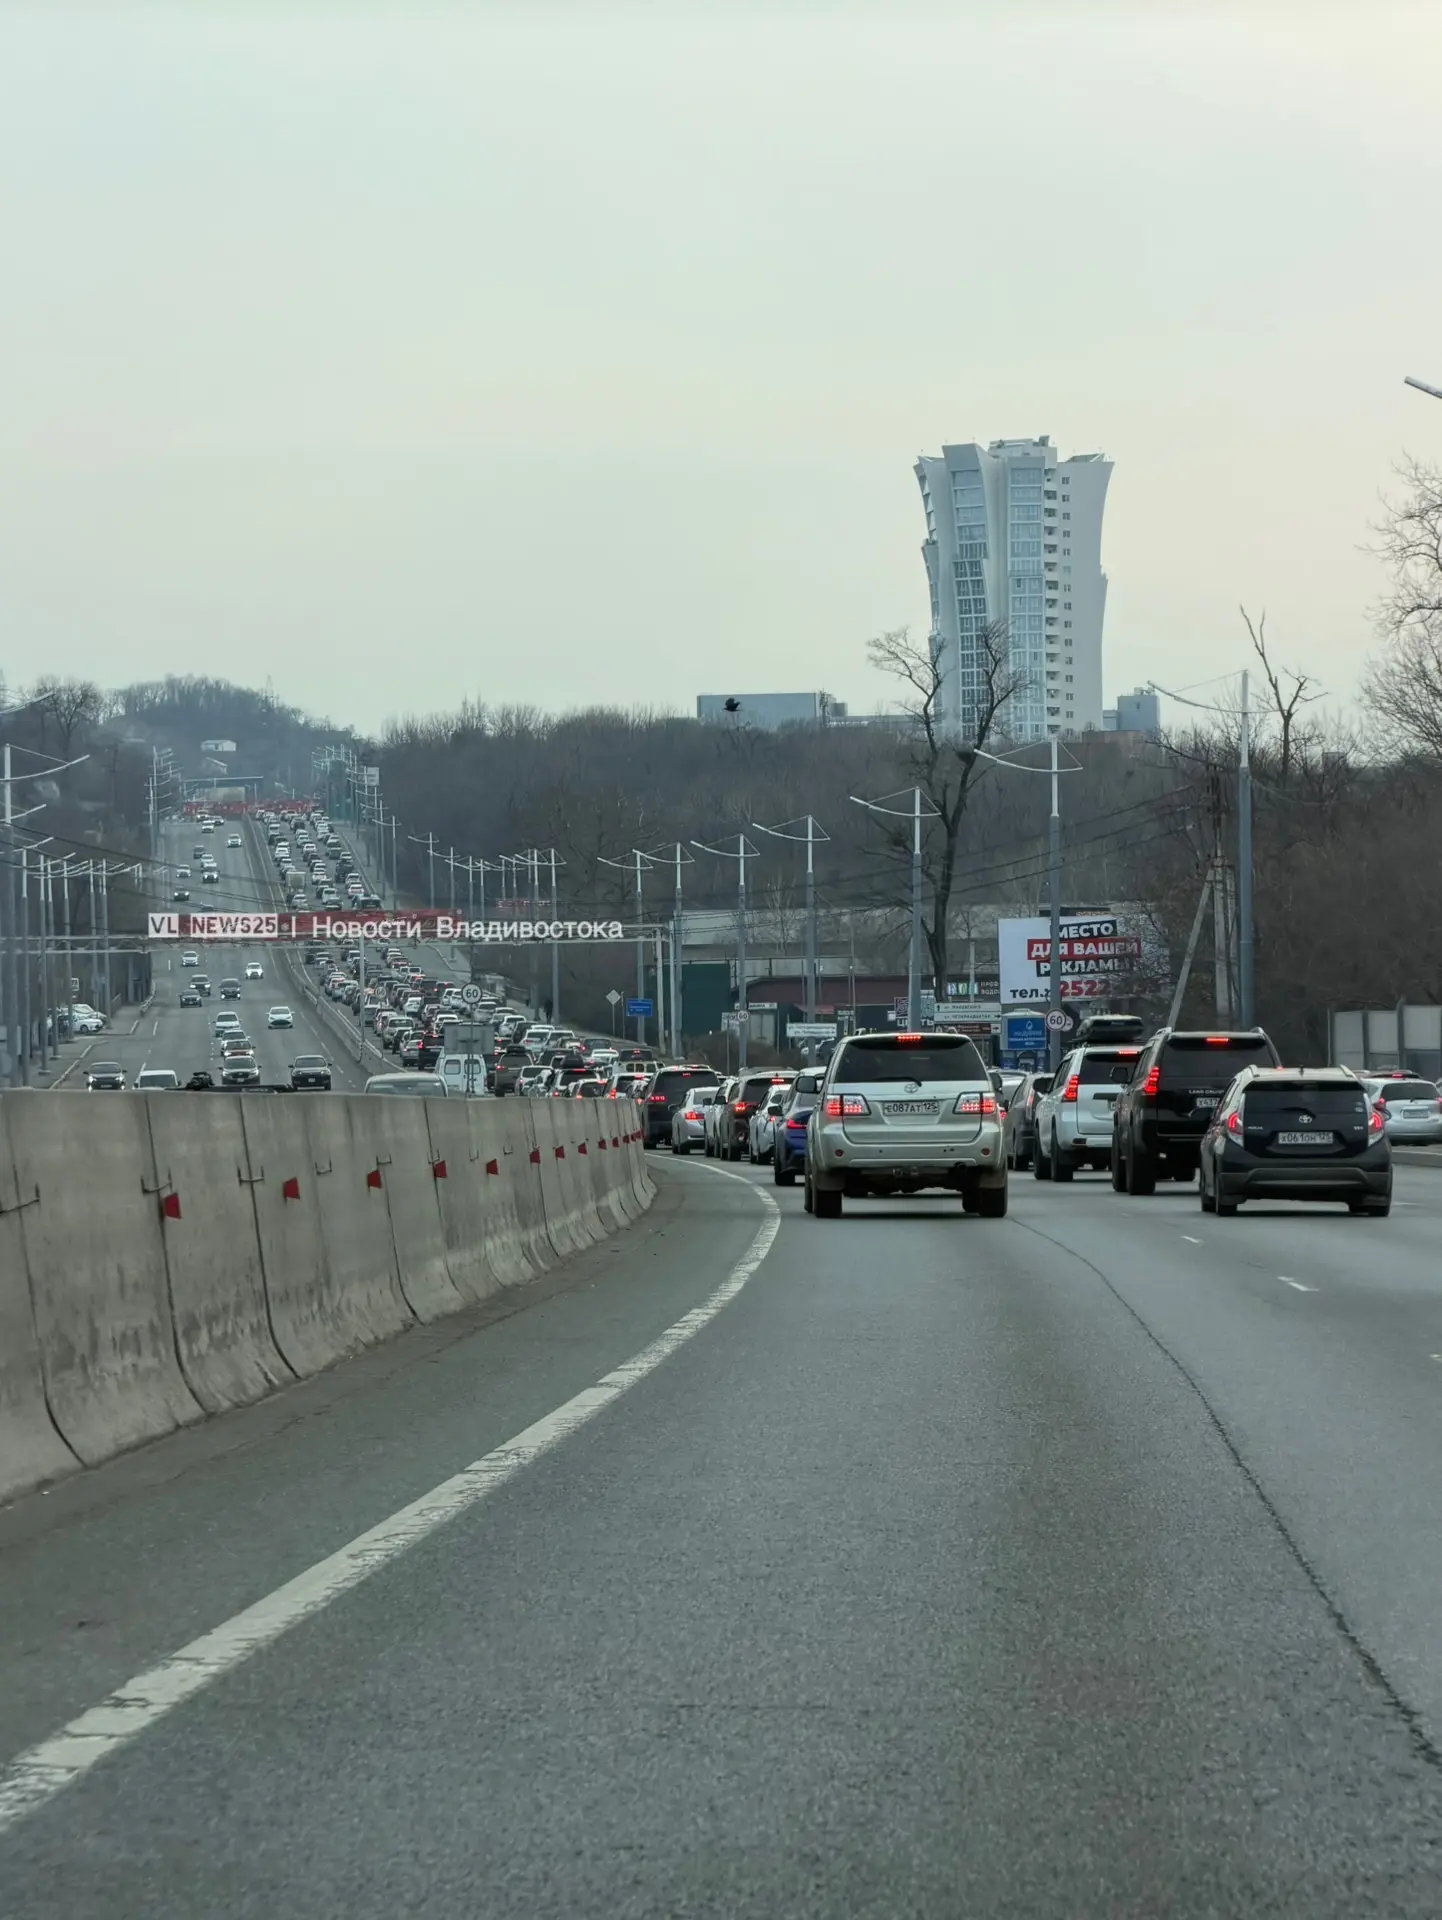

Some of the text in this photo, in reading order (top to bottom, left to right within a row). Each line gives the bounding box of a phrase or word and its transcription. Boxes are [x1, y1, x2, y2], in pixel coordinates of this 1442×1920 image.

[1040, 959, 1130, 975] РКЛАМЫ
[466, 988, 478, 999] 60
[1050, 1015, 1063, 1026] 60
